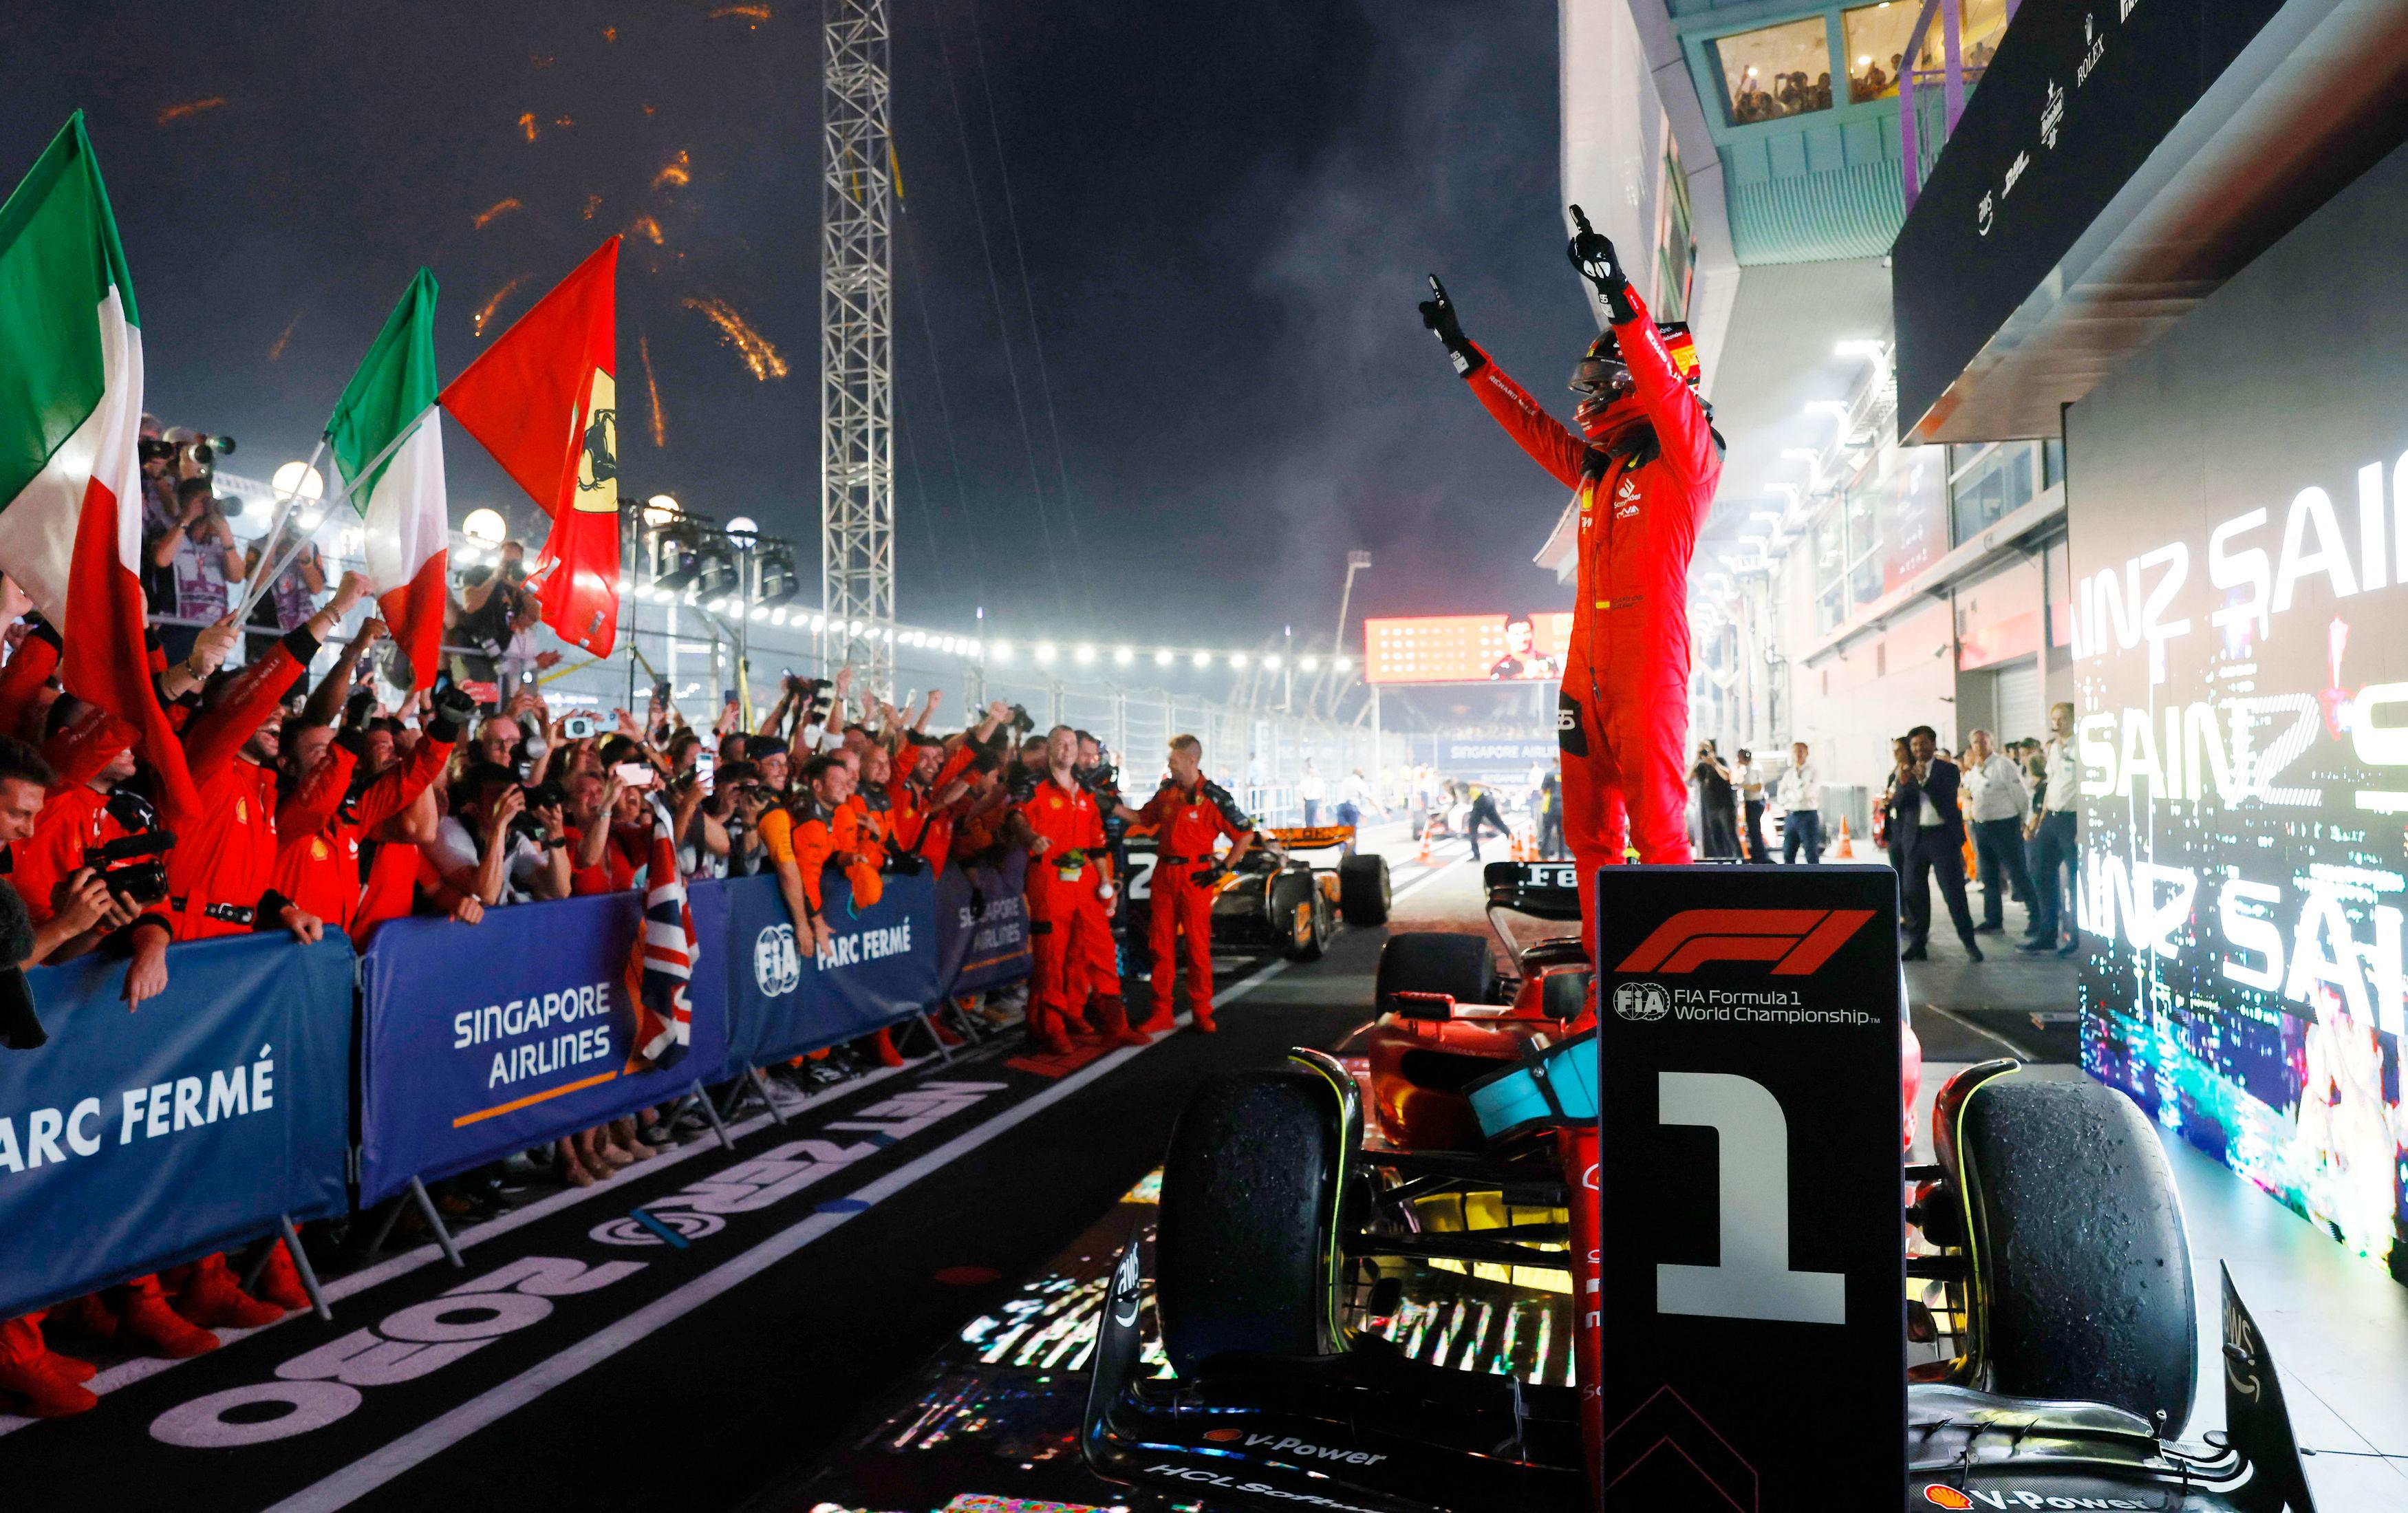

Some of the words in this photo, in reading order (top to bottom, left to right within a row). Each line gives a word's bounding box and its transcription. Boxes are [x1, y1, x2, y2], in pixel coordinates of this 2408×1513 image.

[2077, 33, 2105, 88] ROLEX
[1979, 190, 1992, 224] aws
[1645, 329, 1668, 363] RICHARD
[1488, 375, 1518, 400] RICHARD
[2078, 692, 2322, 808] SAINZ
[1128, 852, 1159, 900] 2
[959, 897, 1019, 928] SIAPORE
[817, 933, 859, 971] PARC
[863, 915, 912, 961] FERMÉ
[454, 982, 610, 1049] SINGAPORE
[1674, 989, 1705, 1003] FIA
[1709, 989, 1788, 1005] Formula
[1790, 990, 1801, 1006] 1
[1674, 1006, 1730, 1022] World
[488, 1025, 610, 1089] AIRLINES
[120, 1043, 274, 1146] FERMÉ
[824, 1080, 1009, 1140] NET
[1656, 1071, 1846, 1325] 1
[1117, 1241, 1139, 1296] aws
[148, 1256, 651, 1448] 2030
[1244, 1433, 1388, 1466] V-Power
[1142, 1464, 1234, 1488] HCL
[1968, 1490, 2150, 1510] V-Power
